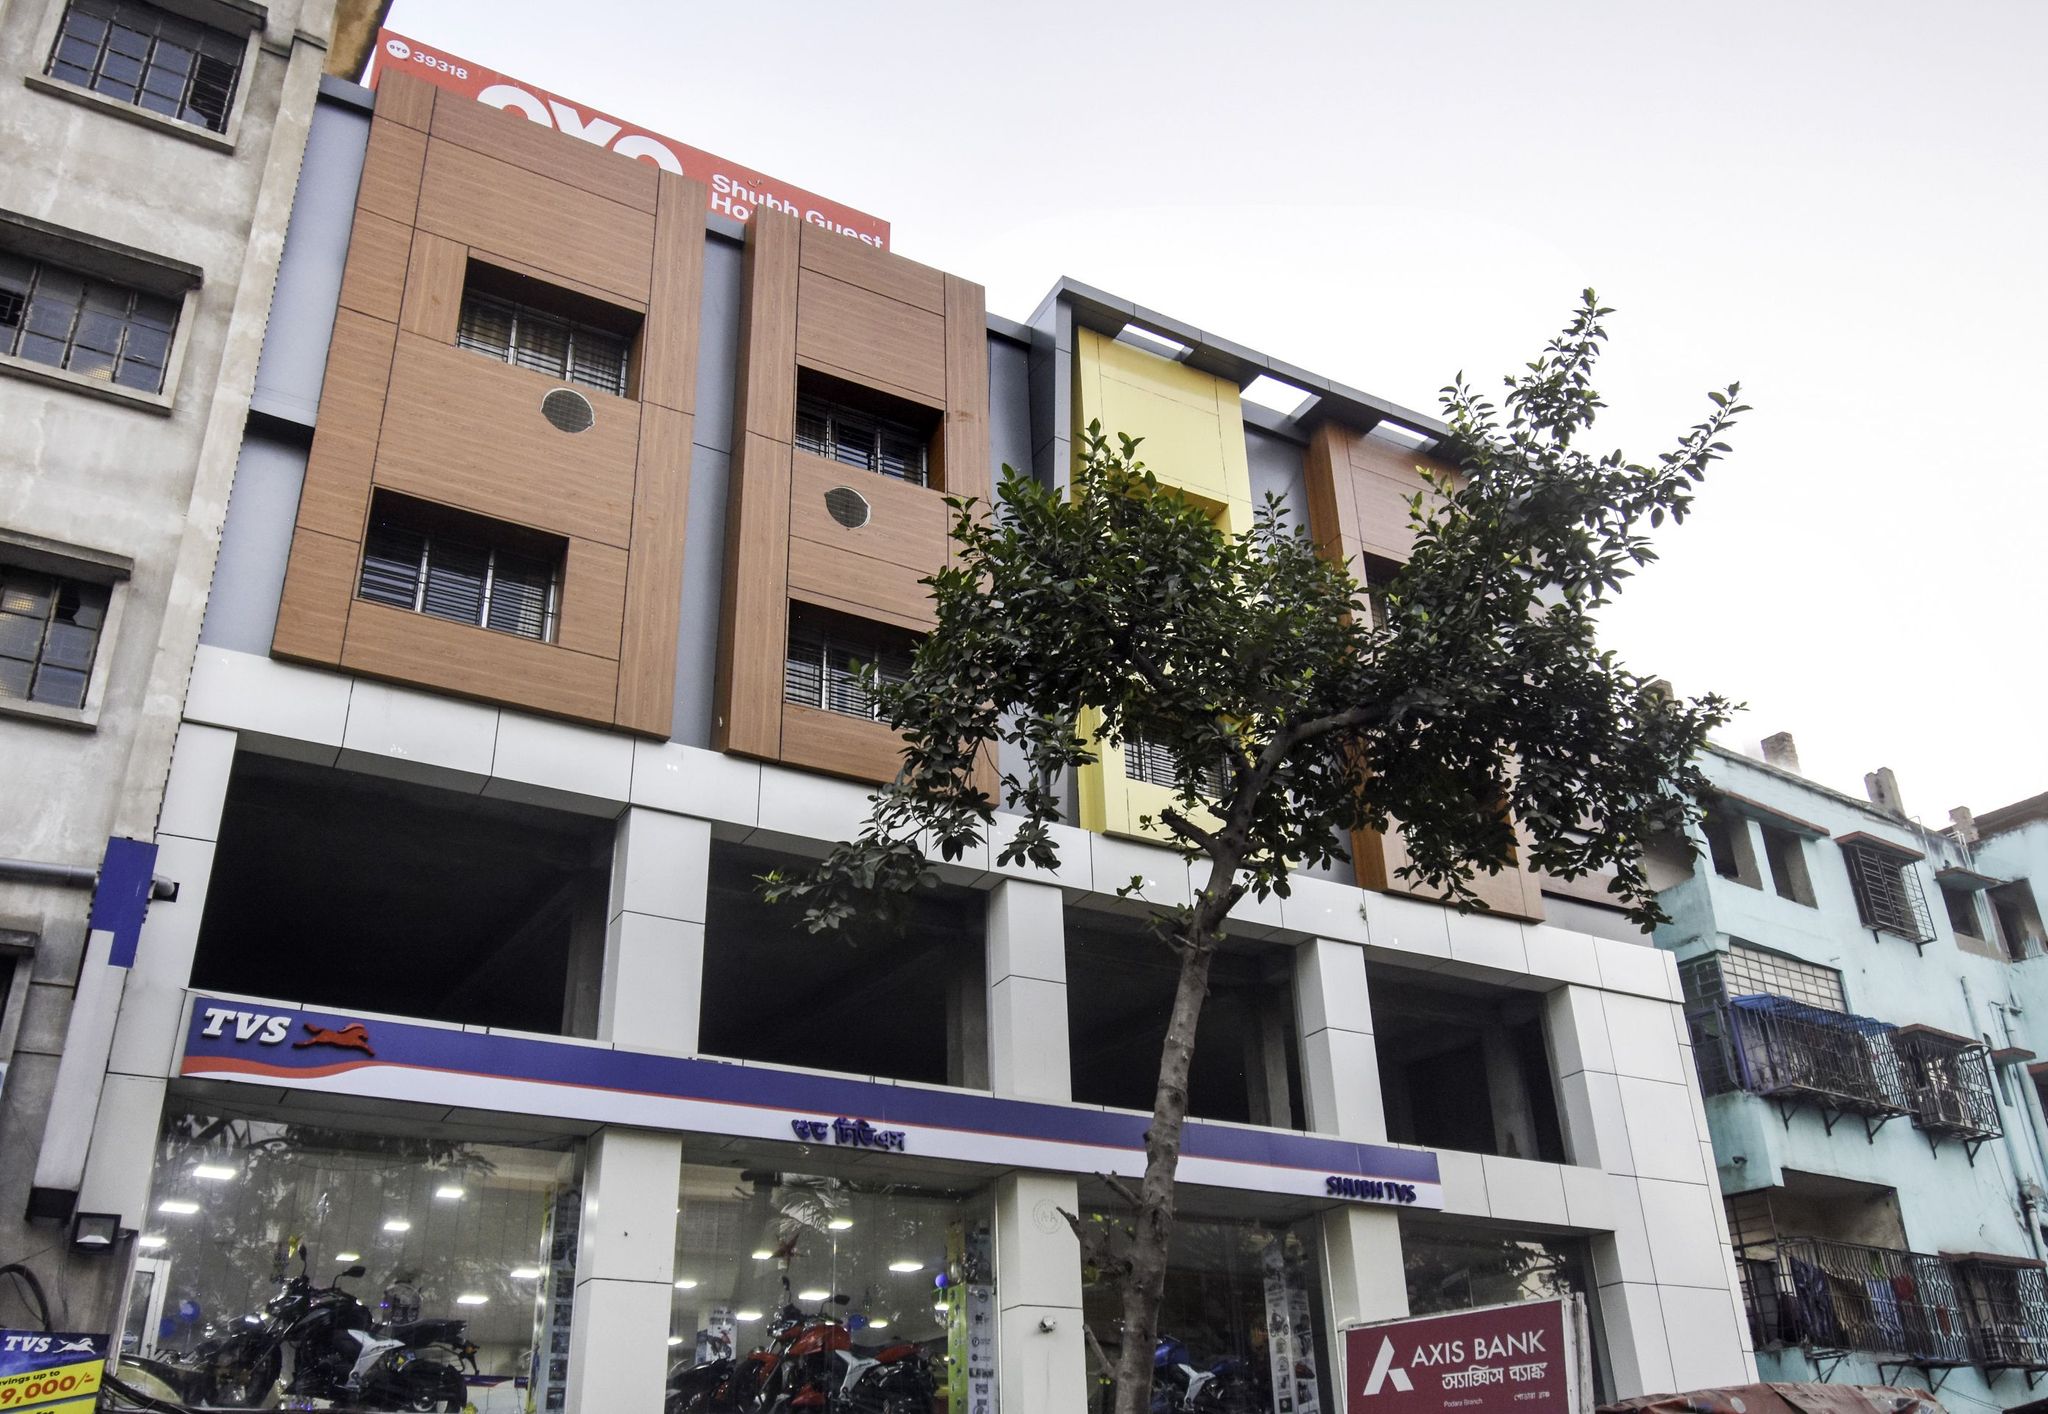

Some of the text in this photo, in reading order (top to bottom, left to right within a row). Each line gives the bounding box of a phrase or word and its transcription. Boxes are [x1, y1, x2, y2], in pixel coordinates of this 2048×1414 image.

[412, 51, 468, 80] 39318
[201, 1007, 292, 1045] TVS
[1326, 1176, 1417, 1204] SHUBH TVS
[4, 1335, 52, 1353] TVS
[1410, 1329, 1547, 1368] AXIS BANK
[0, 1376, 31, 1386] vings
[33, 1372, 47, 1380] up
[1463, 1398, 1483, 1406] Branch
